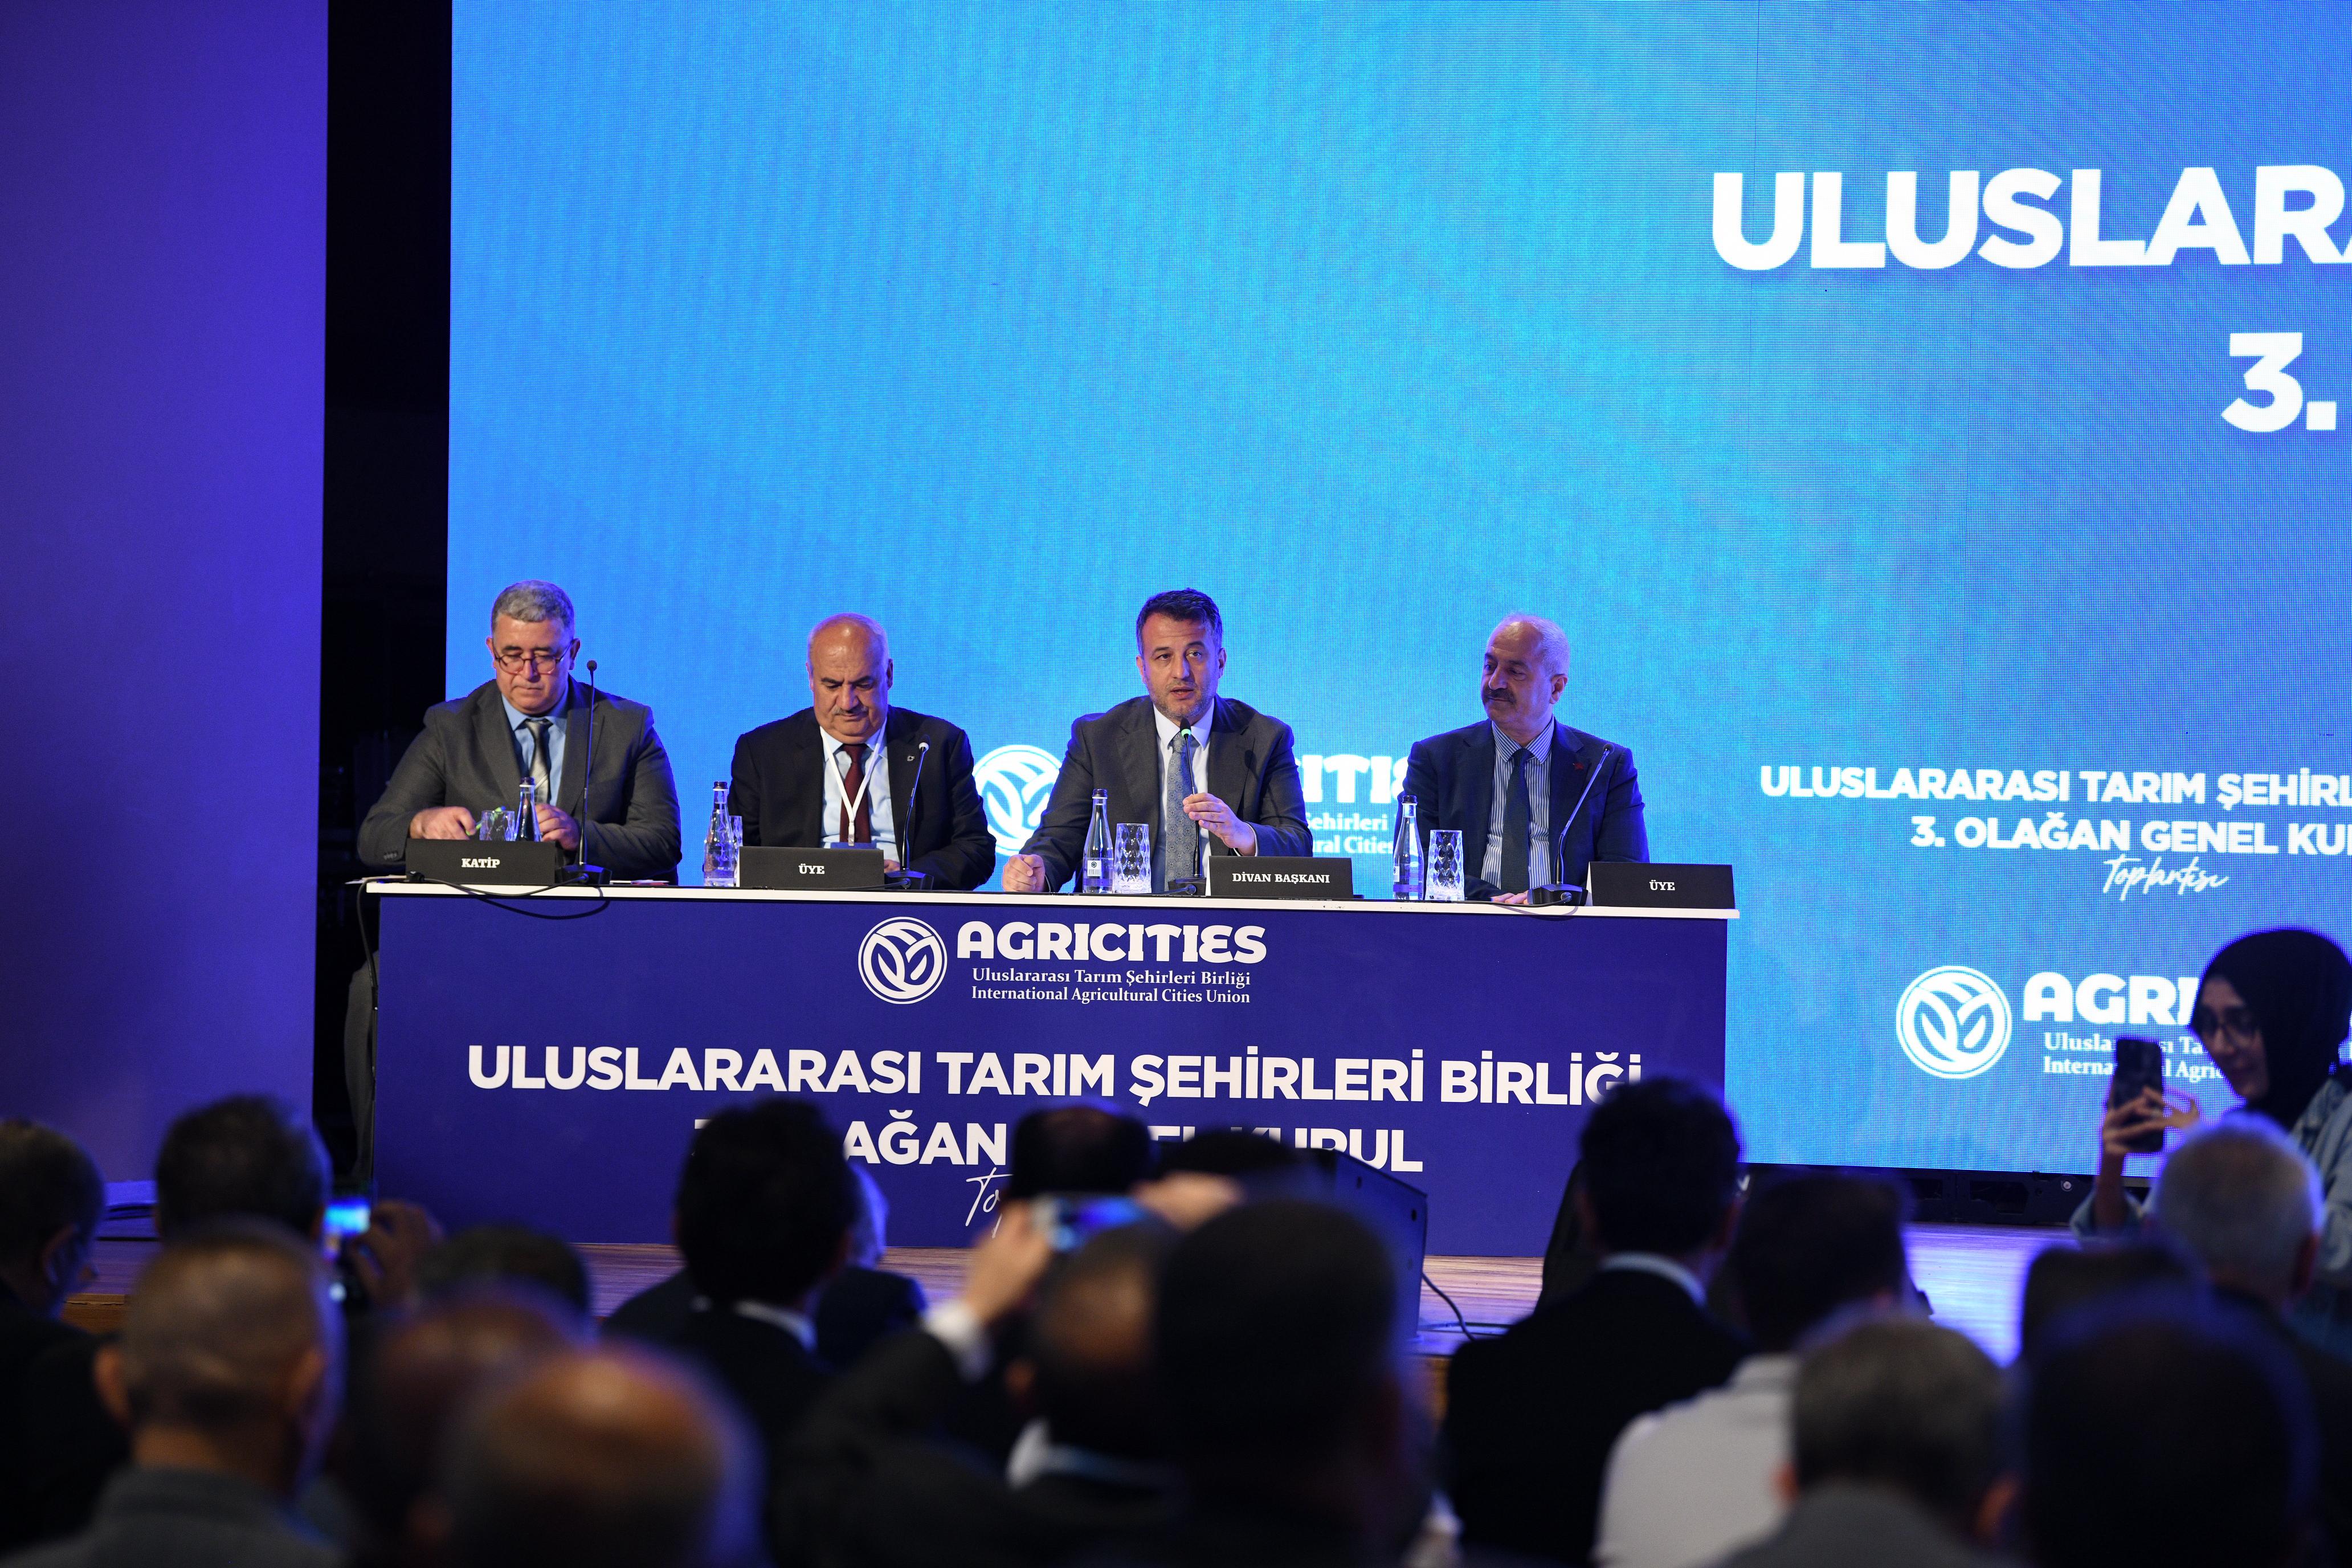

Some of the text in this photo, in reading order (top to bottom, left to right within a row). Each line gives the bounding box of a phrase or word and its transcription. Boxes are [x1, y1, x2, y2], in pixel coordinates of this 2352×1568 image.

[1713, 165, 2352, 270] ULUSLAR
[2222, 332, 2336, 432] 3.
[1761, 766, 2069, 801] ULUSLARARASI
[2080, 771, 2206, 803] TARIM
[1911, 812, 2352, 855] 3. OLAĞAN GENEL KU
[461, 856, 500, 868] KATİP
[798, 863, 825, 875] ÜYE
[1232, 872, 1330, 884] DİVAN BAŞKANI
[1649, 879, 1676, 891] ÜYE
[957, 921, 1267, 964] AGRICITIES
[972, 986, 1250, 1004] International Agricultural Cities Union
[973, 967, 1251, 987] Uluslararası Tarım Şehirleri Birliği
[468, 1045, 921, 1094] ULUSLARARASI
[936, 1052, 1114, 1097] TARIM
[1129, 1046, 1424, 1107] ŞEHİRLERİ
[843, 1109, 1007, 1166] AĞAN
